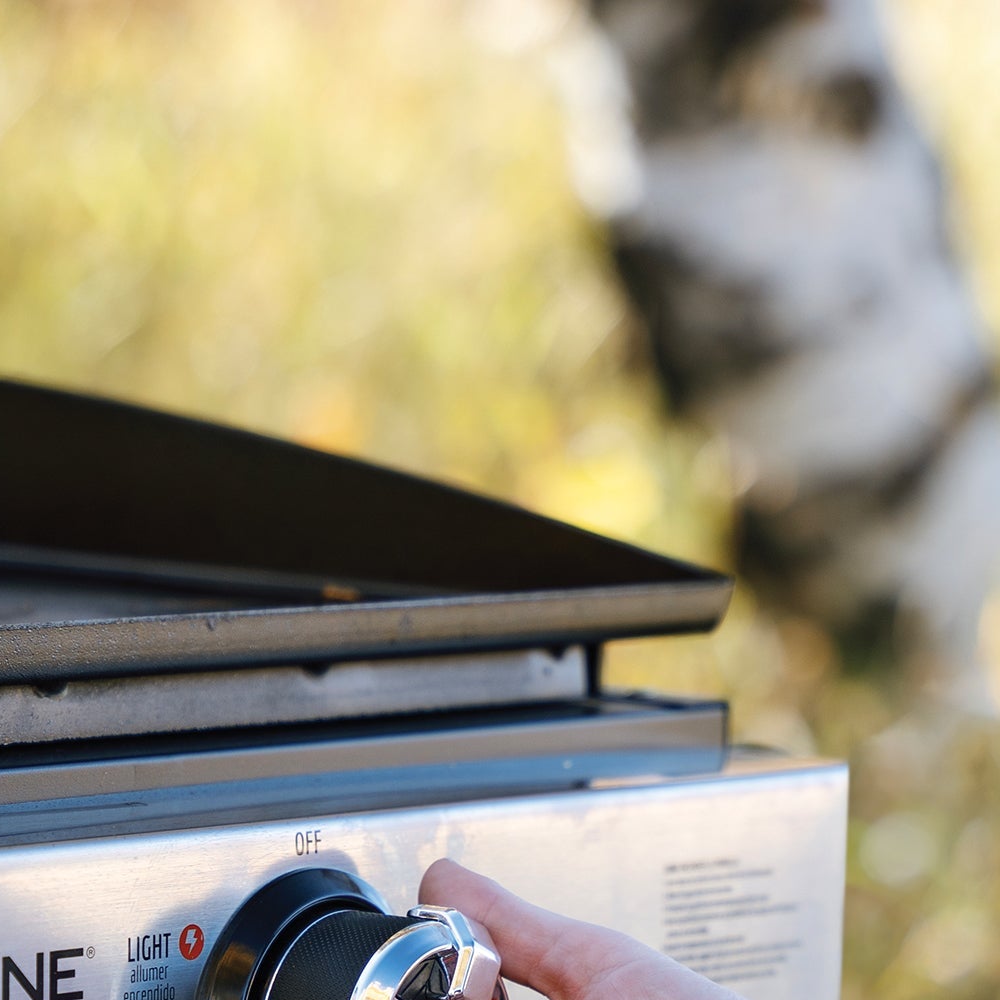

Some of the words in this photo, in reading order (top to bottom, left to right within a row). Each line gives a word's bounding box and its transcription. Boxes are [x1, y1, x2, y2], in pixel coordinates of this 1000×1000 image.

[295, 830, 321, 856] OFF
[127, 933, 171, 962] LIGHT
[130, 965, 168, 984] allumer
